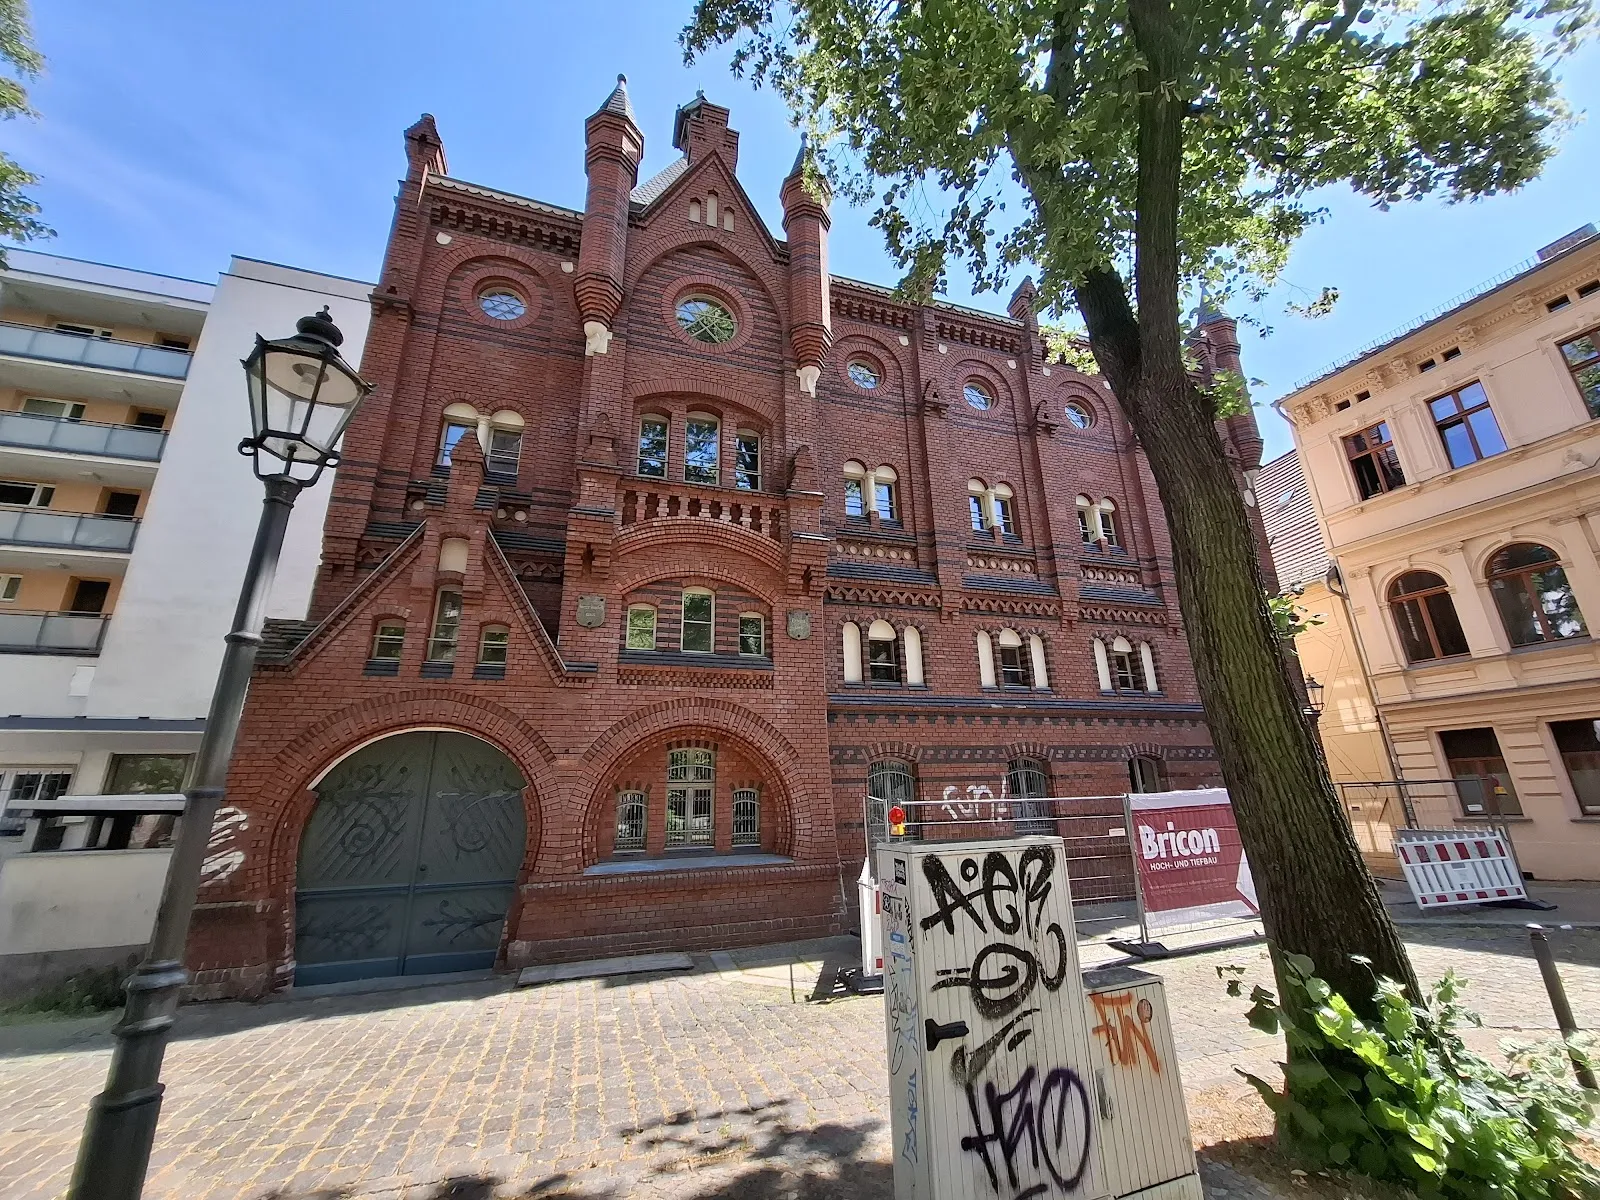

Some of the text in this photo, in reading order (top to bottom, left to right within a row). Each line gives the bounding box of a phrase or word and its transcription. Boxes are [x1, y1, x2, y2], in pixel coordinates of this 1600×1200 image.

[1138, 821, 1221, 860] Bricon
[1150, 856, 1218, 871] HOCH- UND TIEFBAU
